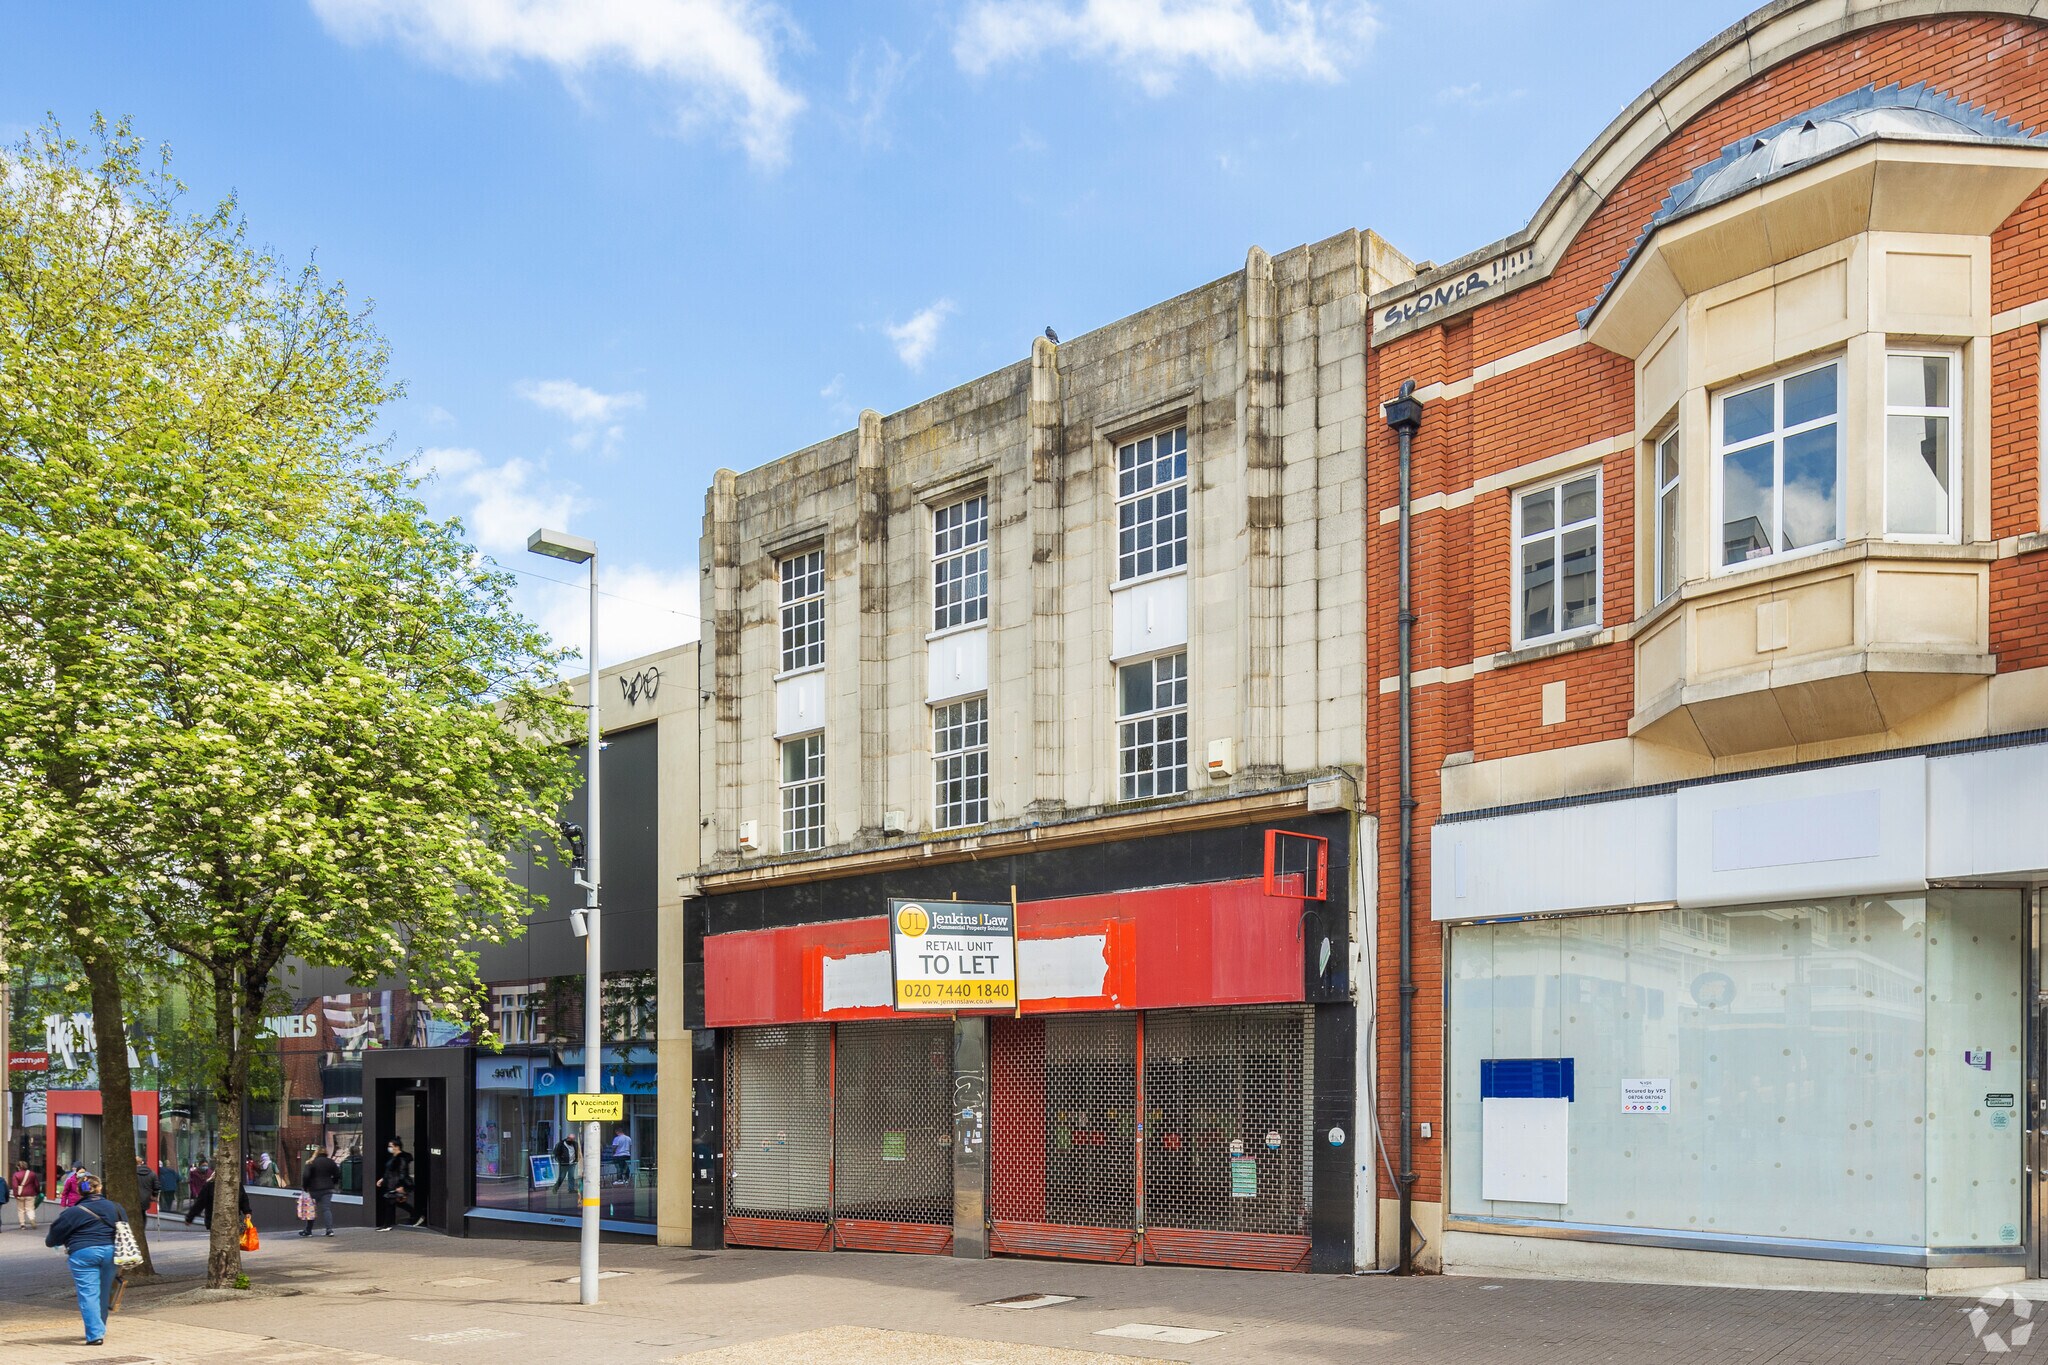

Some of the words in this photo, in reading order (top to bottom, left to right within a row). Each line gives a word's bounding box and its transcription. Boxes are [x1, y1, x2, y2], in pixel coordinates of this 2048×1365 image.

[932, 912, 978, 930] Jenkins
[984, 914, 1008, 926] Law
[926, 941, 963, 951] RETAIL
[967, 942, 993, 951] UNIT
[919, 955, 949, 974] TO
[960, 956, 999, 974] LET
[904, 984, 931, 997] 020
[937, 984, 971, 997] 7440
[977, 984, 1009, 996] 1840
